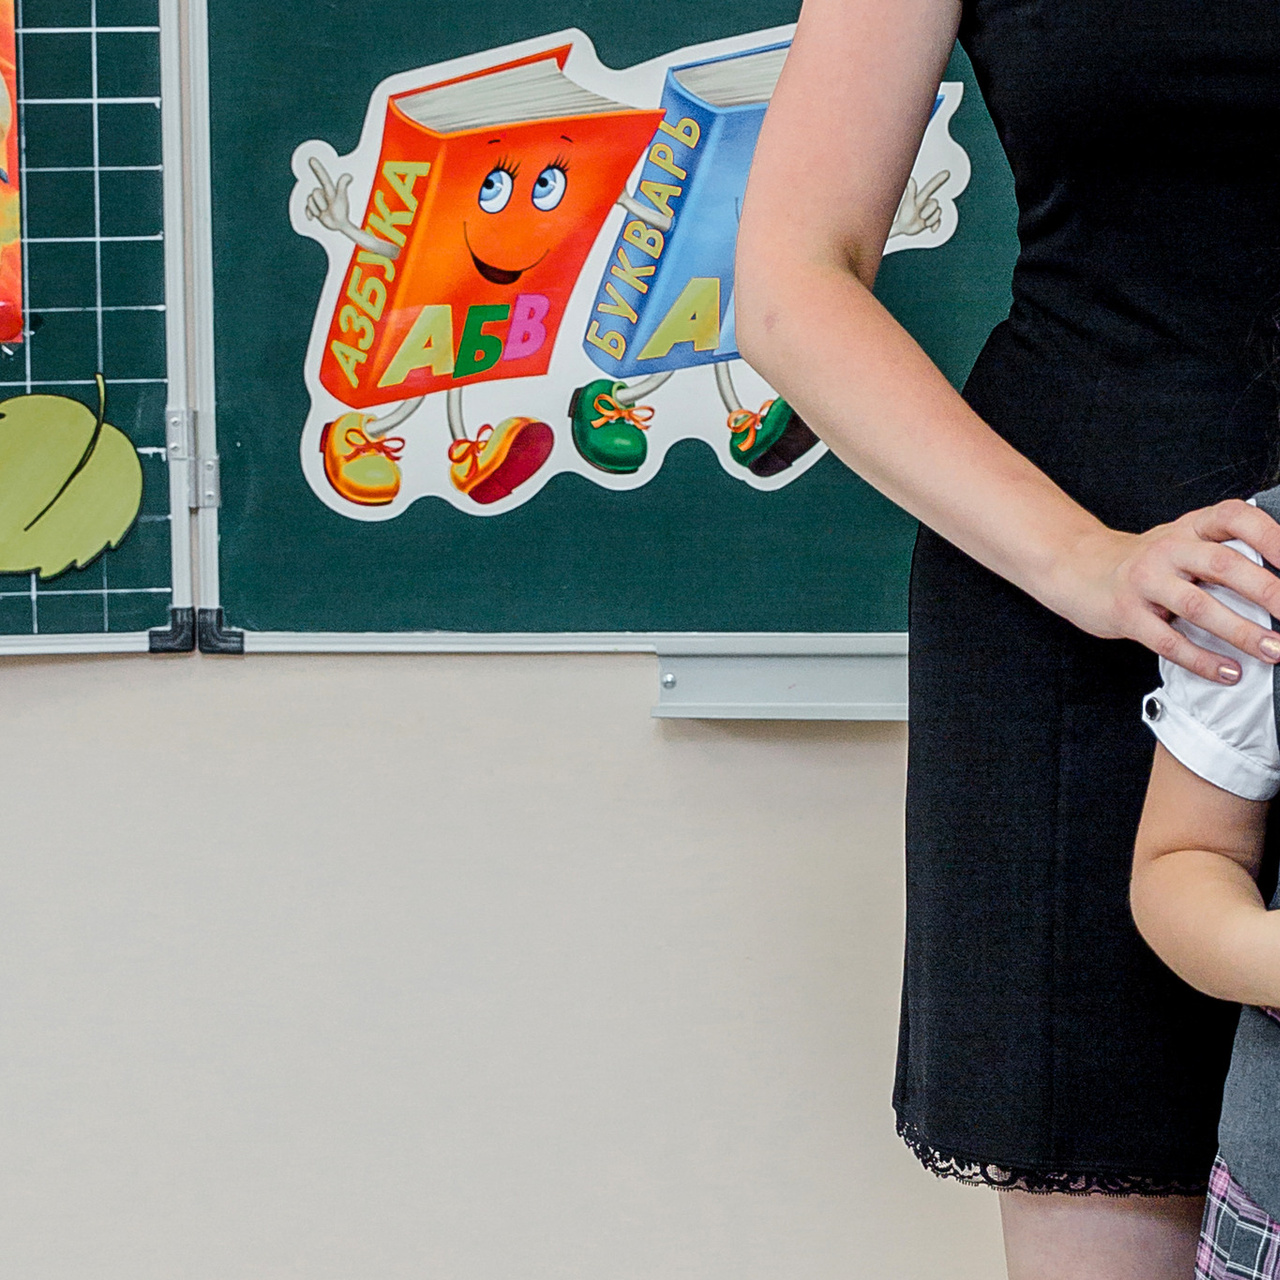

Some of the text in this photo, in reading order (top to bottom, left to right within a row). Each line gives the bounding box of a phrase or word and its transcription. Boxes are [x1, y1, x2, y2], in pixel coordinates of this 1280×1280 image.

[330, 160, 431, 389] АЗБУКА
[376, 292, 550, 388] АБВ
[586, 115, 702, 361] БУКВАРЬ
